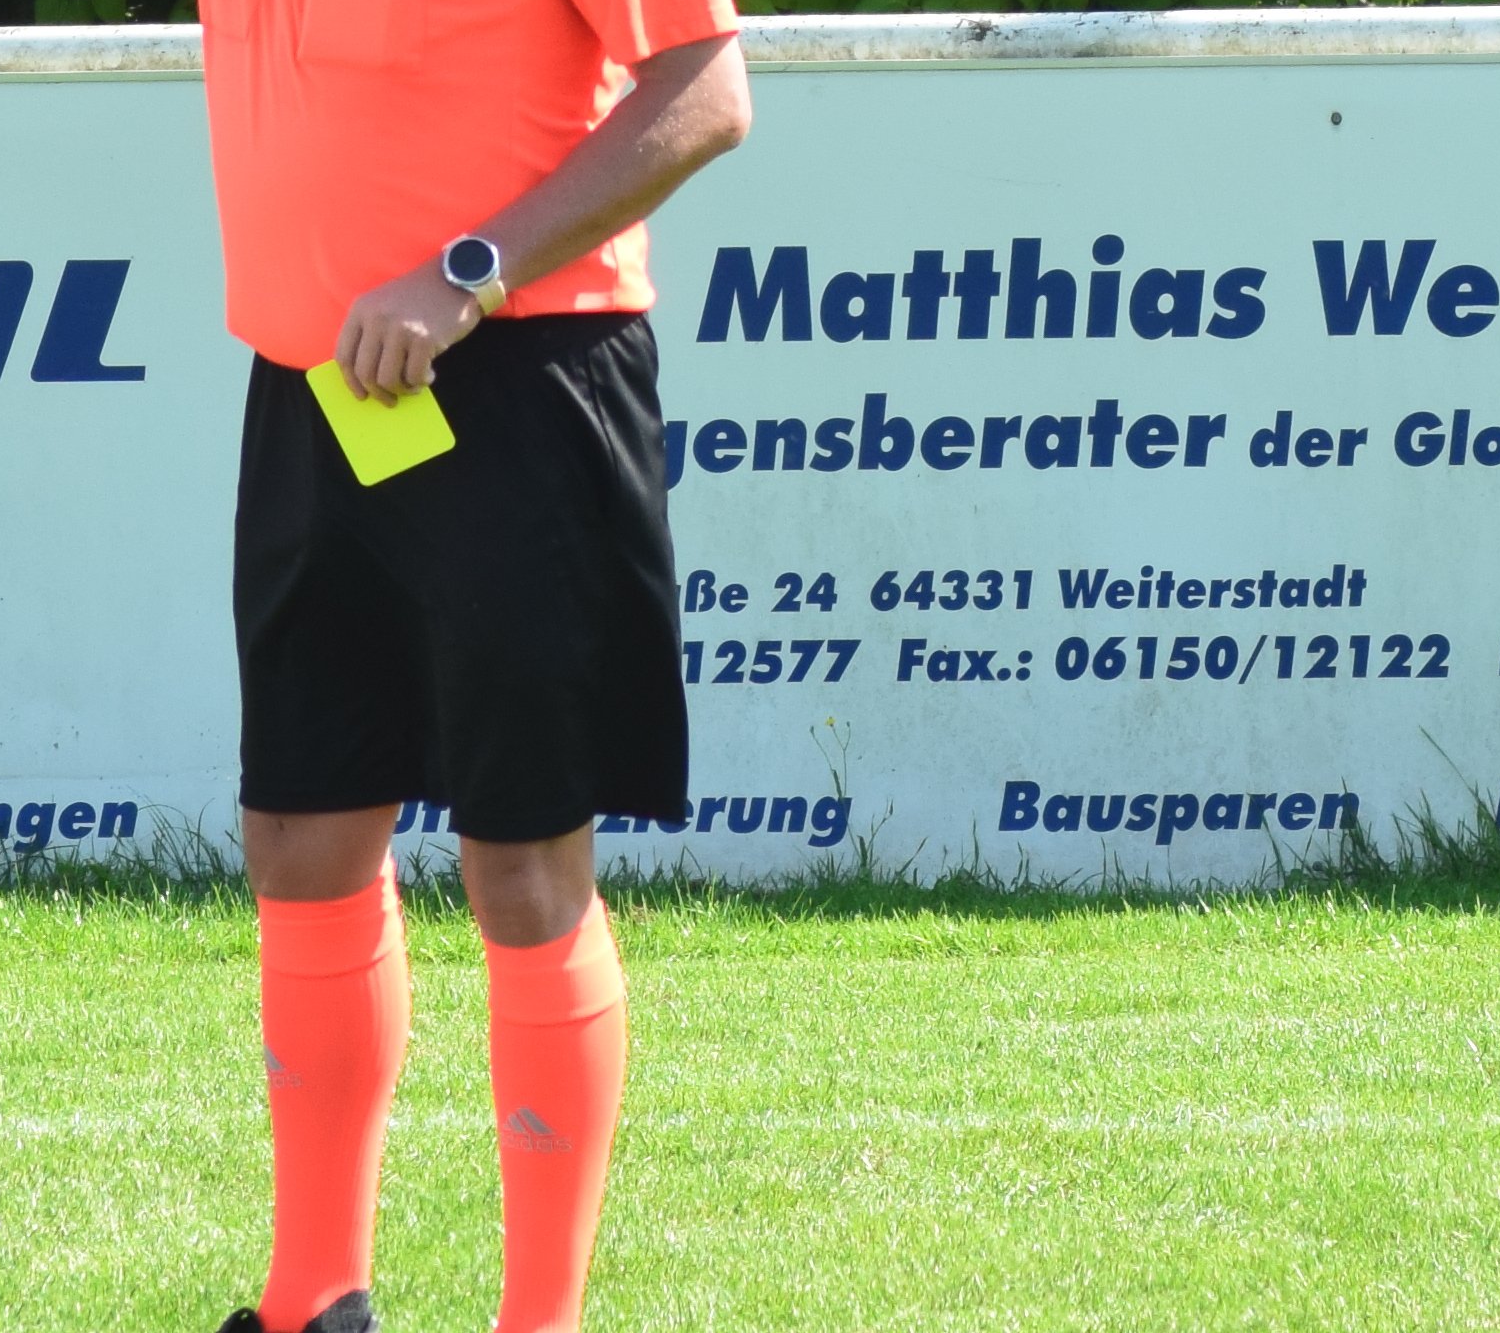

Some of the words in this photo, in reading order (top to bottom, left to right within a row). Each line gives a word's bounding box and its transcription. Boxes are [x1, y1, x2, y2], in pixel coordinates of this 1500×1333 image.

[696, 234, 1267, 343] Matthias
[1250, 411, 1369, 468] der
[771, 571, 838, 613] 24
[869, 569, 1034, 612] 64331
[1058, 564, 1367, 611] Weiterstadt
[896, 638, 1034, 683] Fax.:
[1054, 634, 1451, 684] 06150/12122
[998, 780, 1361, 846] Bausparen
